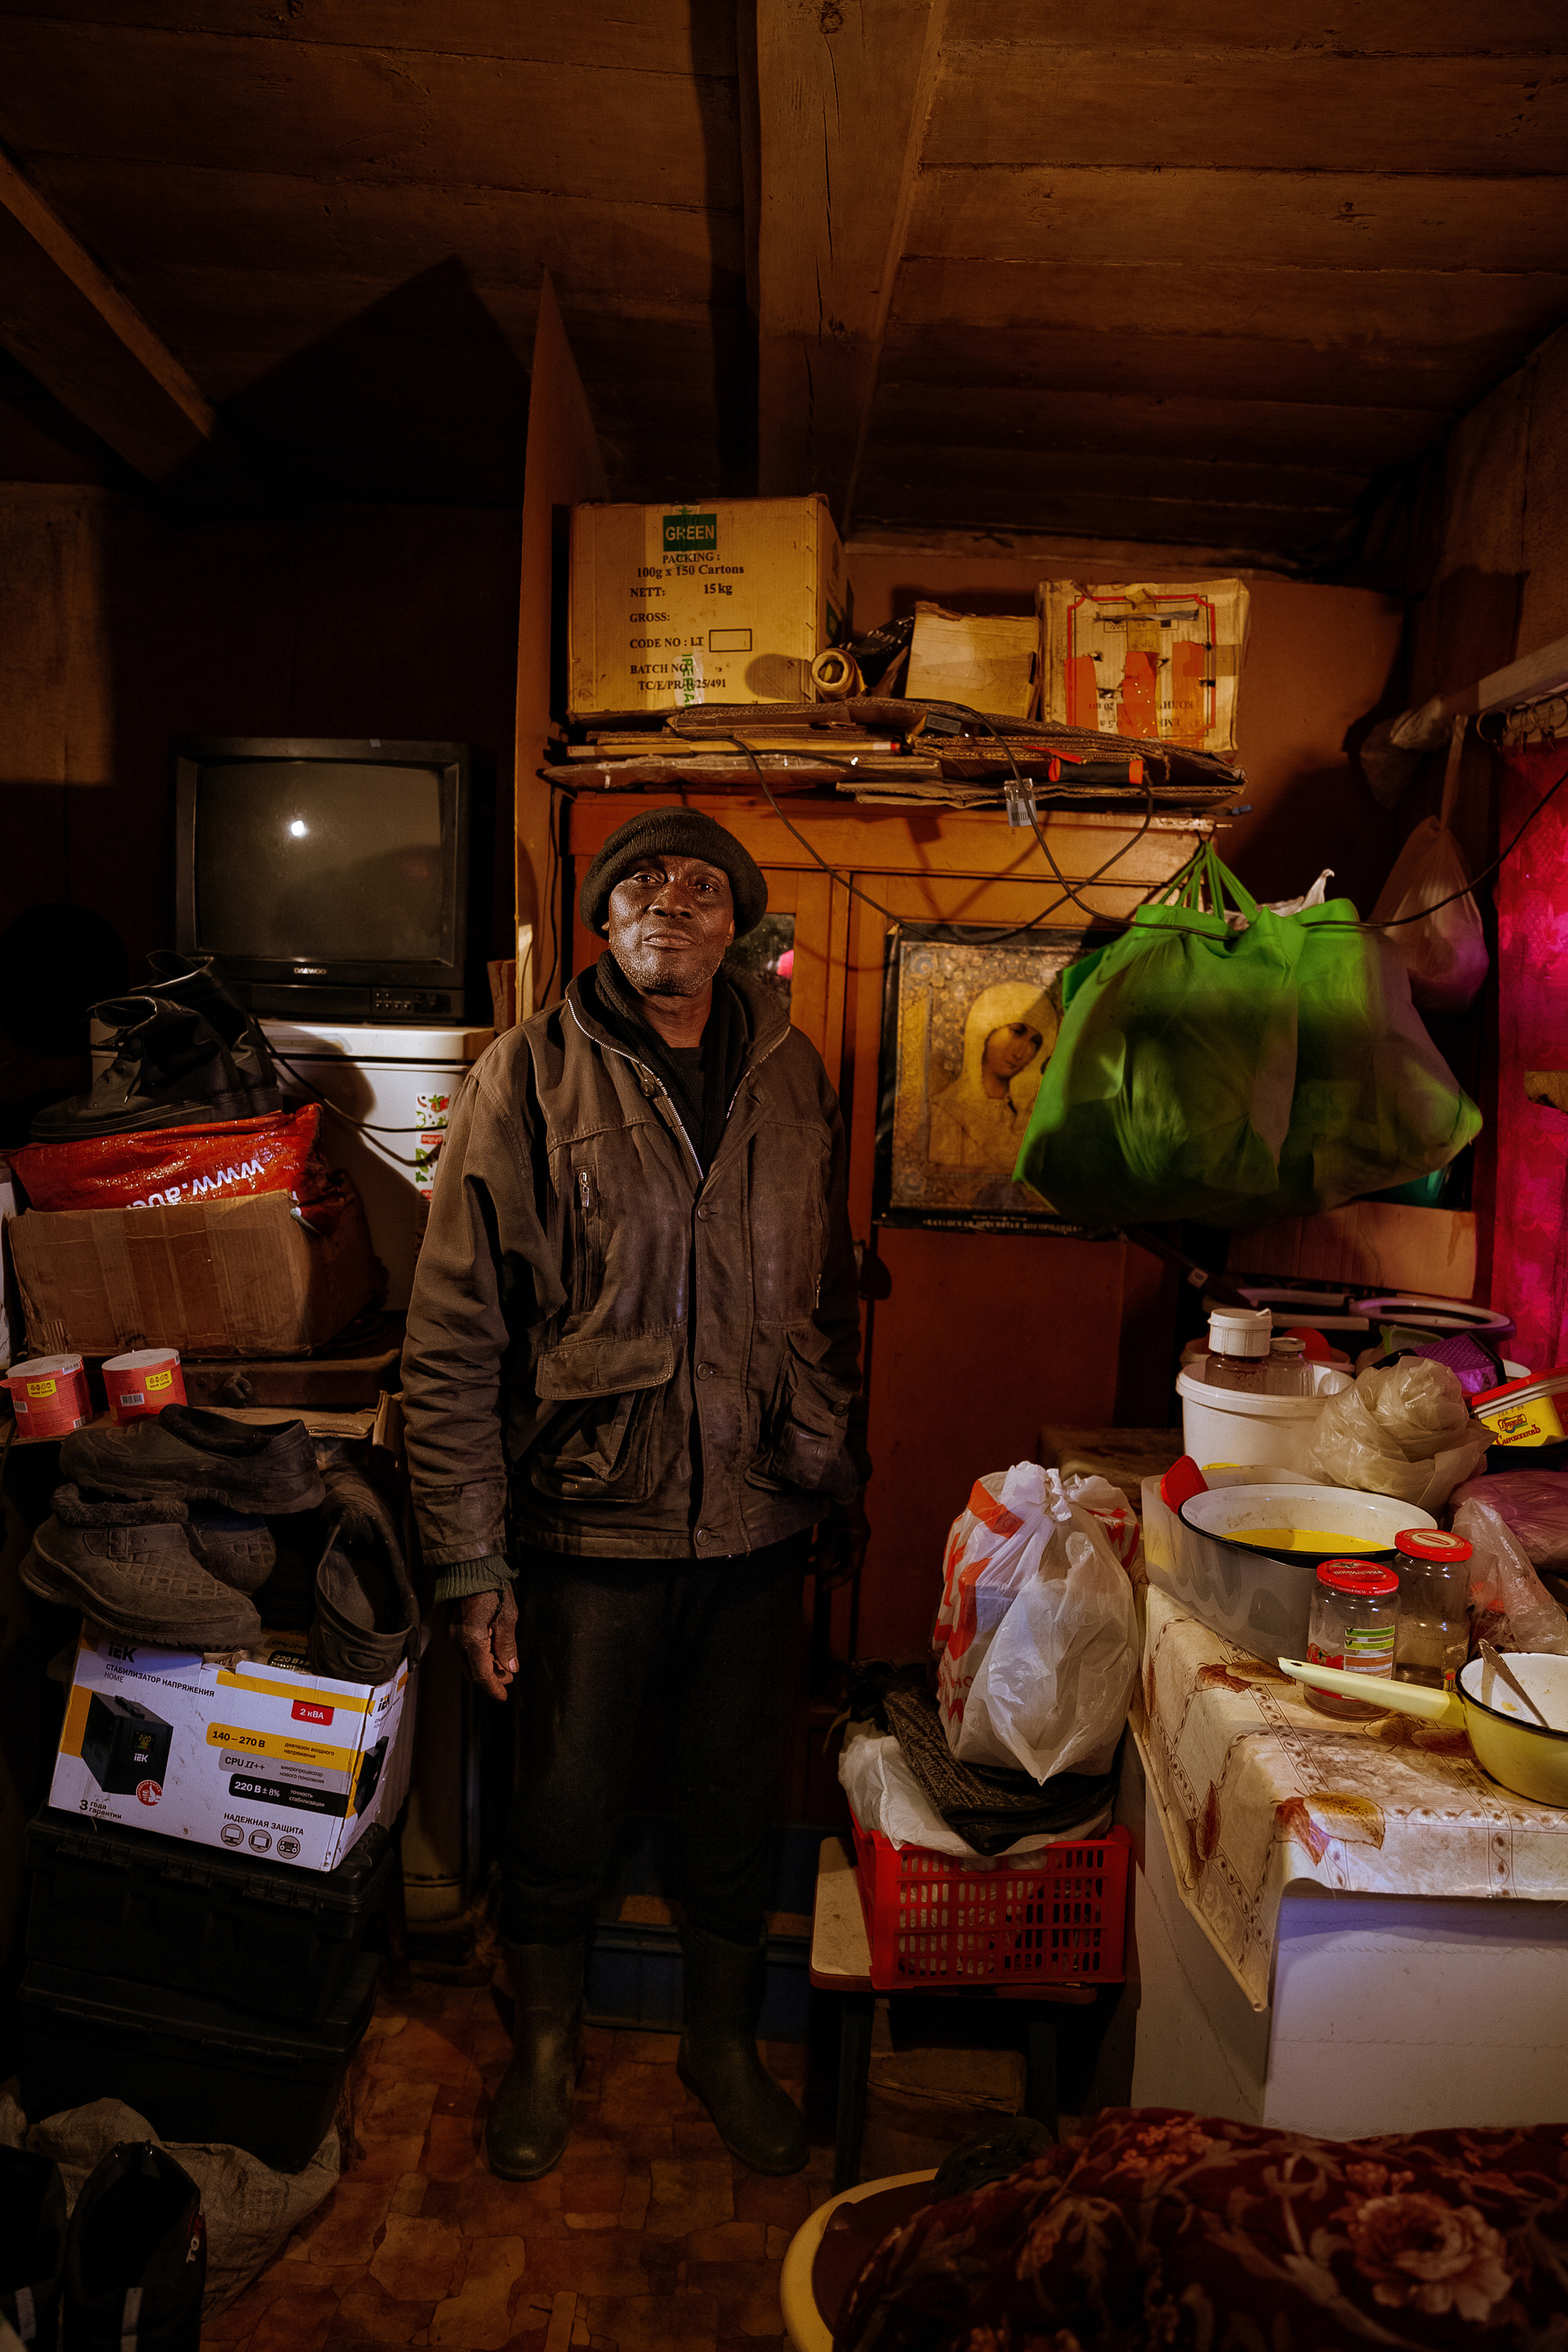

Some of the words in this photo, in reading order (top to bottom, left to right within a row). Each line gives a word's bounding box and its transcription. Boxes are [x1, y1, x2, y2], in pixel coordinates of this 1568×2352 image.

[665, 525, 714, 541] GREEN
[637, 567, 663, 579] 100g
[676, 565, 695, 576] 150
[698, 564, 745, 575] Cartons
[630, 587, 666, 598] NETT:
[704, 584, 716, 595] 15
[717, 582, 733, 596] kg
[630, 612, 670, 623] GROSS:
[630, 638, 662, 649] CODE
[665, 637, 681, 647] NO
[690, 636, 704, 647] LT
[630, 663, 668, 674] BATCH
[273, 1654, 291, 1663] 220
[104, 1672, 124, 1683] HOME
[106, 1664, 161, 1684] СТАБИЛИЗАТОР
[162, 1679, 215, 1697] НАПРЯЖЕНИЯ
[307, 1711, 325, 1720] кВА
[212, 1731, 230, 1741] 140
[238, 1736, 257, 1747] 270
[284, 1742, 310, 1751] диапазон
[311, 1747, 335, 1756] входного
[284, 1749, 316, 1759] напряжения
[225, 1756, 244, 1766] CPU
[281, 1765, 323, 1777] микропроцессор
[298, 1774, 325, 1784] поколения
[234, 1781, 253, 1792] 220
[290, 1789, 314, 1799] точность
[79, 1799, 89, 1811] 3
[90, 1801, 107, 1810] года
[288, 1795, 325, 1807] стабилизации
[89, 1807, 122, 1819] гарантии
[224, 1812, 270, 1828] НАДЕЖНАЯ
[271, 1822, 304, 1836] ЗАЩИТА
